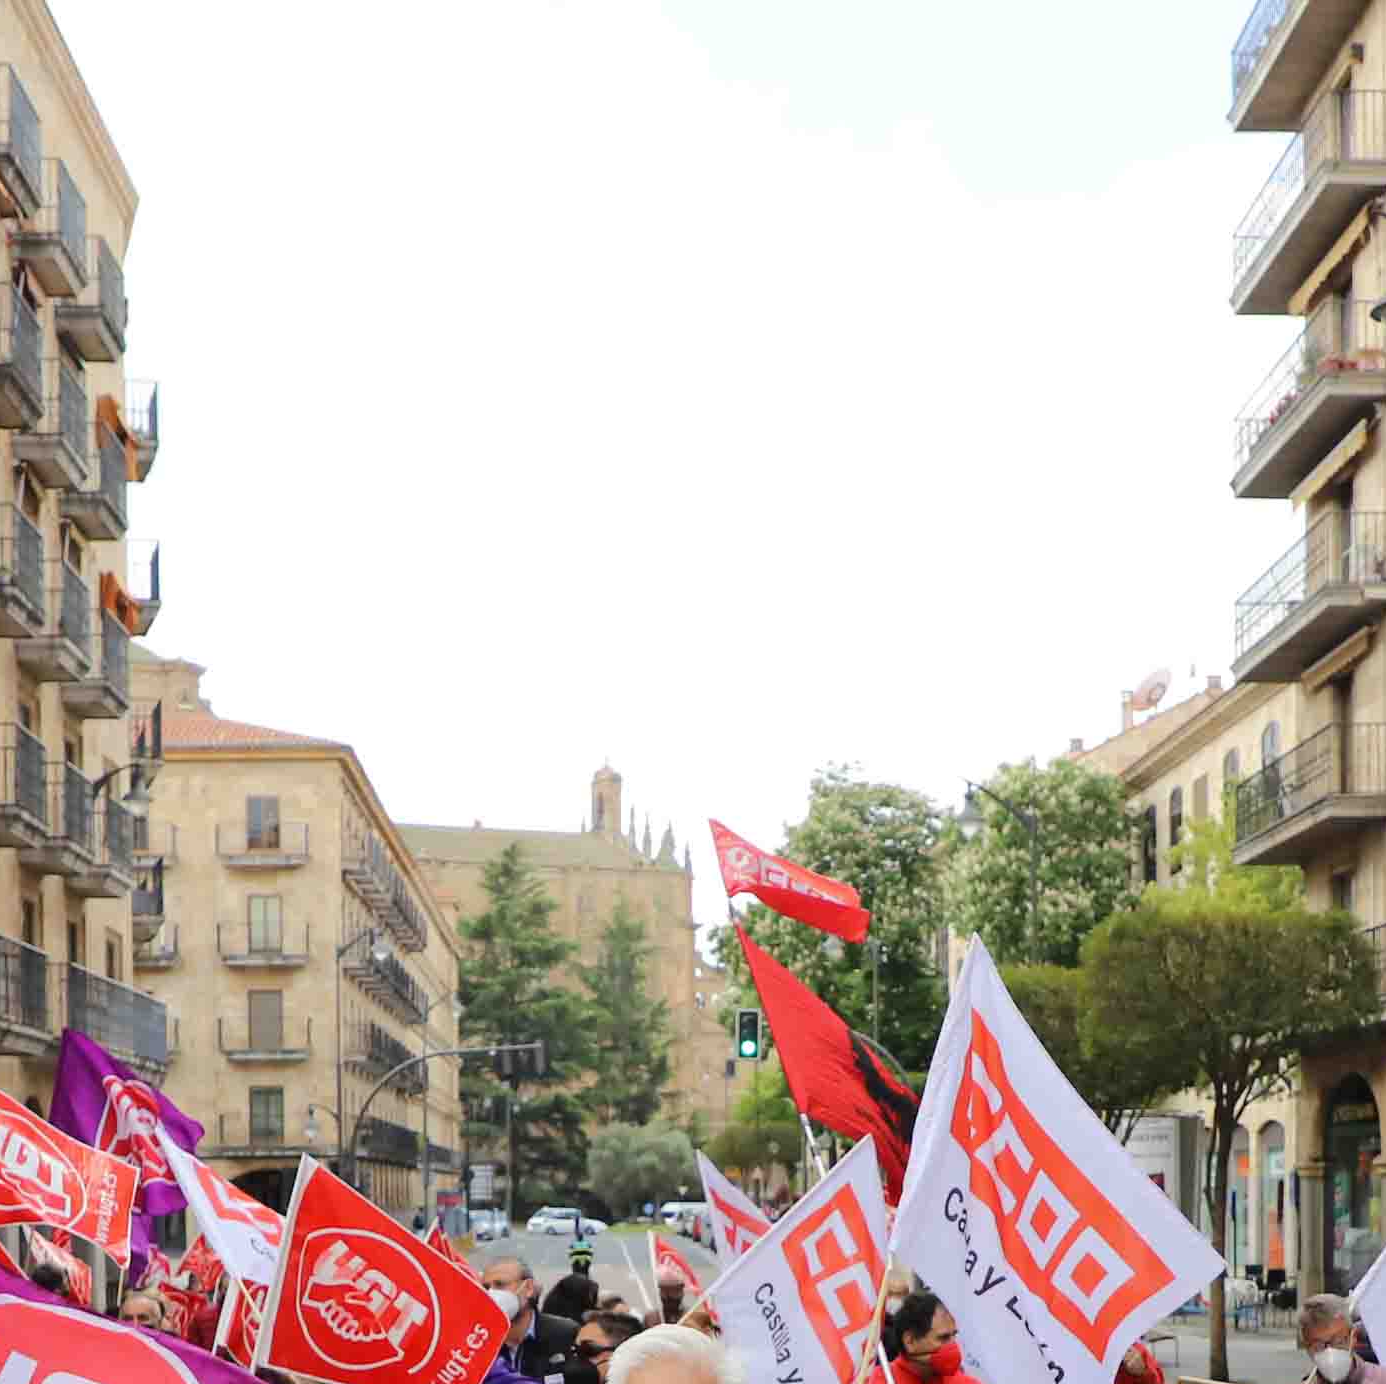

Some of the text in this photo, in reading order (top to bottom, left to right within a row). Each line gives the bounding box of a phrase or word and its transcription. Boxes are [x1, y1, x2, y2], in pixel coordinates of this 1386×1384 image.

[965, 1050, 1137, 1327] CCOO
[313, 1239, 430, 1348] UGT
[754, 1282, 793, 1365] Castilla
[974, 1265, 1006, 1297] y
